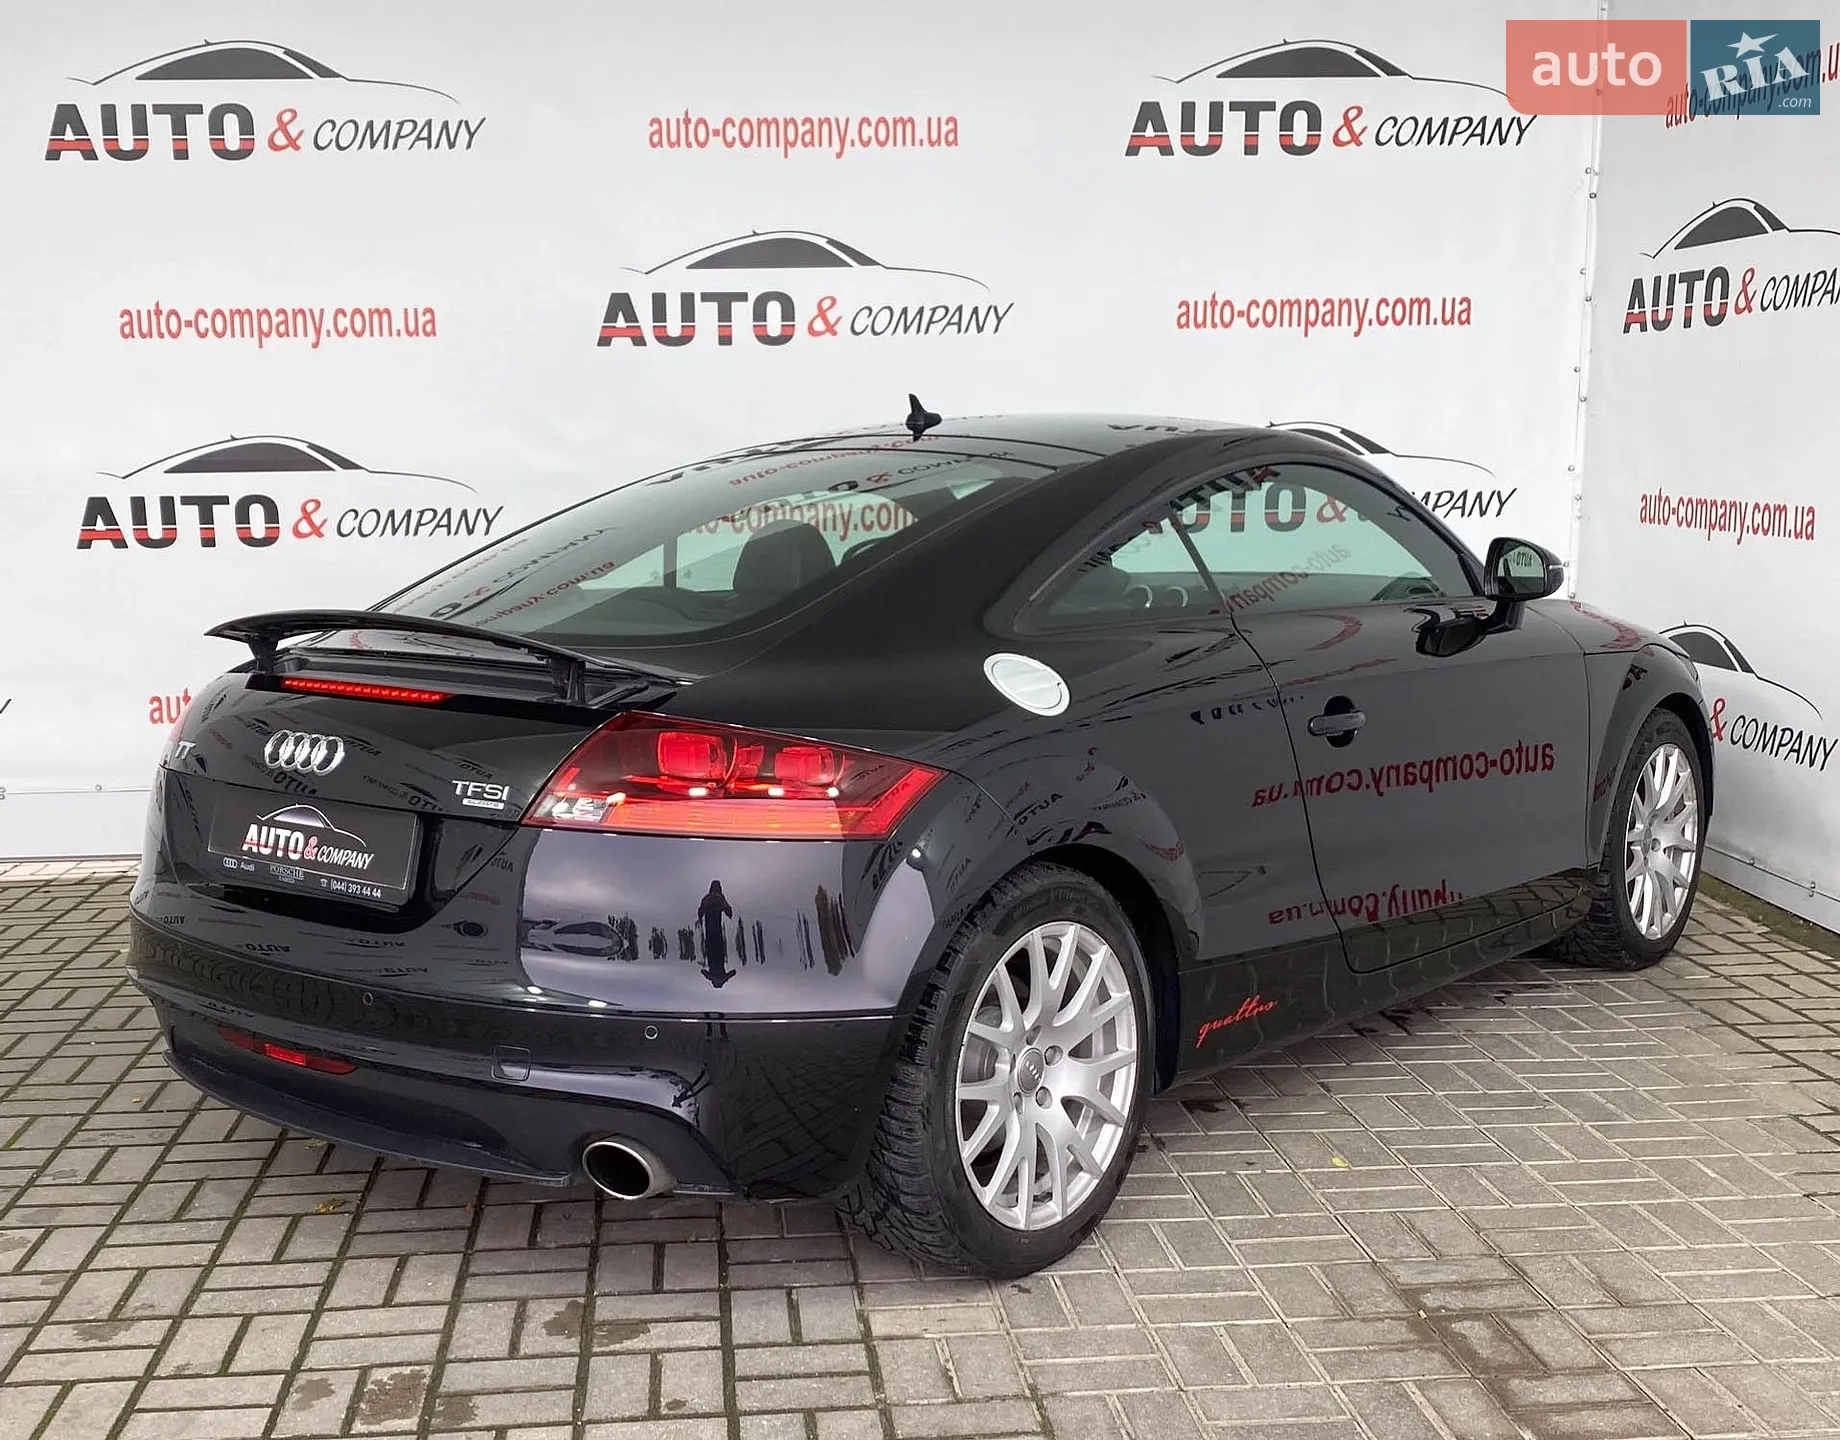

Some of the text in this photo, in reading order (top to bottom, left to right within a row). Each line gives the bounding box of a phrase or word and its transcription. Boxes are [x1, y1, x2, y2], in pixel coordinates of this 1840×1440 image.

[45, 103, 486, 161] AUTO & COMPANY
[648, 109, 959, 159] auto-company.com.ua
[1125, 101, 1537, 156] AUTO & COMPANY
[119, 300, 437, 349] auto-company.com.ua
[597, 291, 1014, 347] AUTO & COMPANY
[1176, 291, 1472, 337] auto-company.com.ua
[1623, 266, 1729, 334] AUTO
[1735, 267, 1756, 316] &
[77, 495, 503, 549] AUTO & COMPANY
[1639, 487, 1816, 542] auto-company.com.ua
[1710, 697, 1839, 771] & COMPANY
[452, 779, 510, 801] TFSI
[239, 861, 255, 872] Audi
[241, 824, 374, 869] AUTO & COMPANY
[269, 864, 305, 879] PORSCHE
[330, 878, 382, 899] (044) 393 44 44
